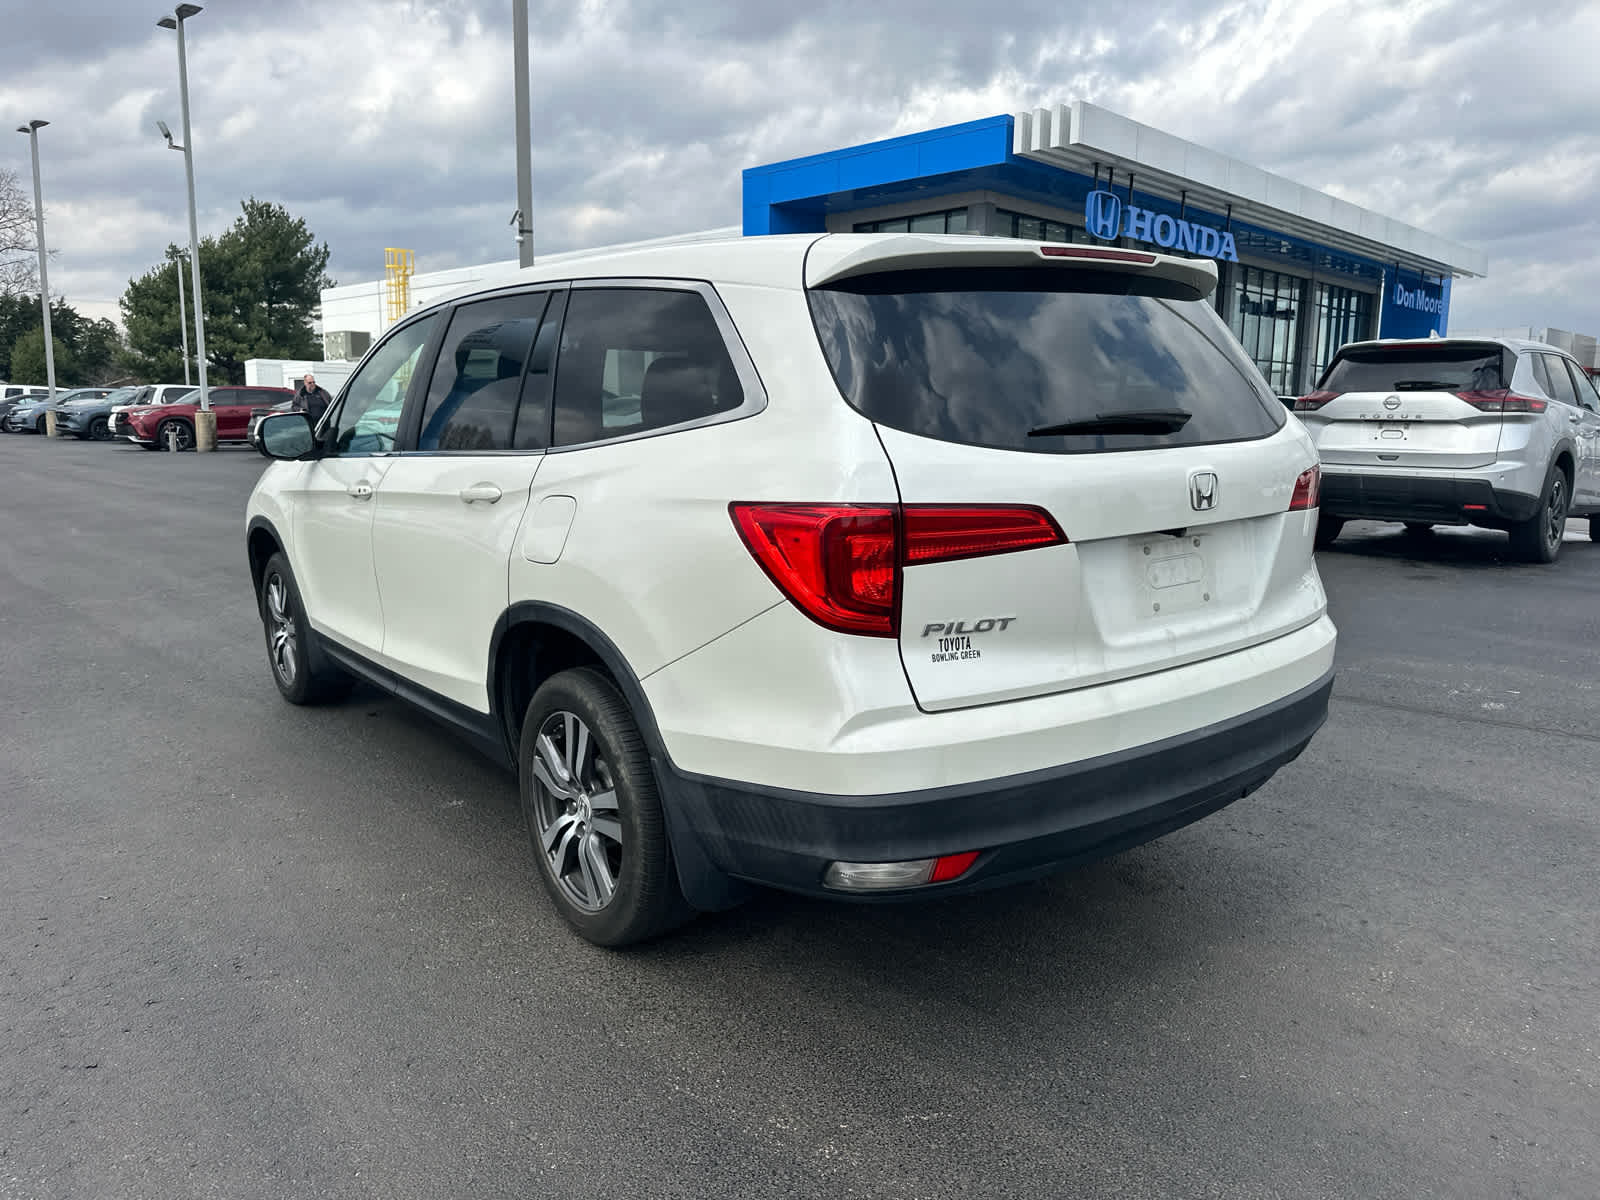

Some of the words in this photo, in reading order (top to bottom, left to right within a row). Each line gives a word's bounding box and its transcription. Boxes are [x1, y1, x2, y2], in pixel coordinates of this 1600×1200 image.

[1122, 205, 1239, 262] HONDA
[1396, 283, 1415, 309] Don
[1416, 288, 1442, 315] Moore
[921, 617, 1017, 637] PILOT
[938, 636, 971, 652] TOYOTA
[931, 652, 959, 662] BOWLING
[960, 649, 981, 660] GREEN
